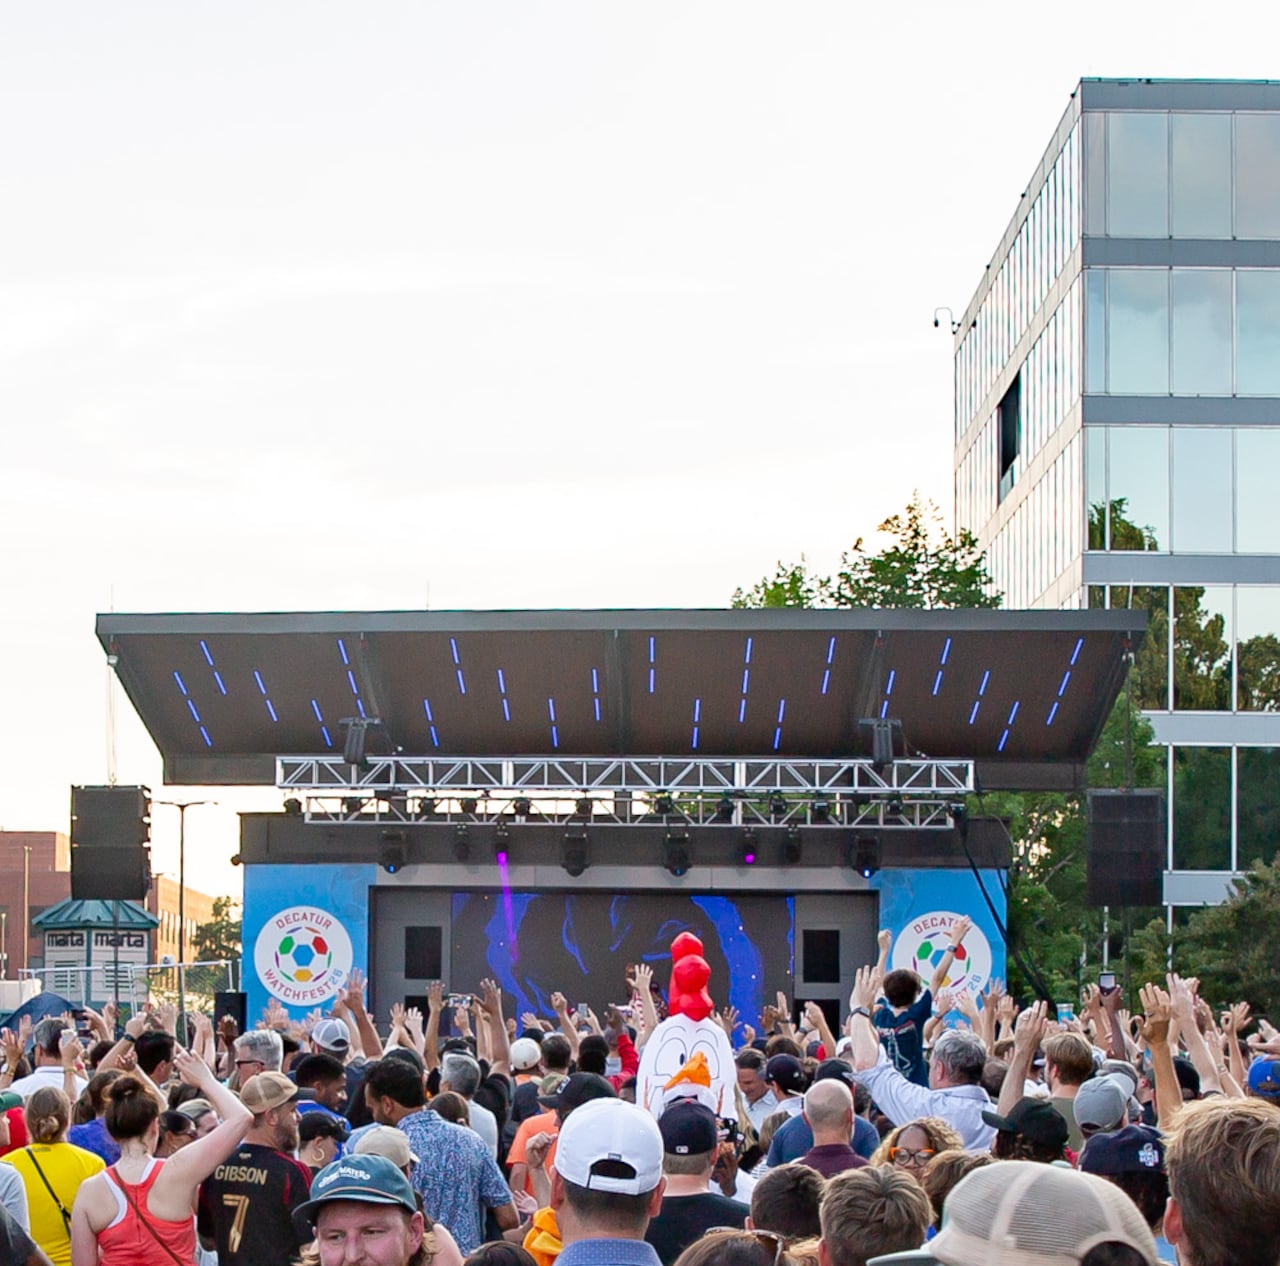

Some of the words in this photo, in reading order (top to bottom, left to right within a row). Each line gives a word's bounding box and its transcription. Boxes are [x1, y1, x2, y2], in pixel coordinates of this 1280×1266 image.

[276, 912, 332, 930] DECATUR
[913, 916, 959, 935] DECAT
[47, 932, 84, 946] marta
[94, 932, 144, 947] marta
[215, 1164, 268, 1185] GIBSON
[222, 1193, 249, 1254] 7
